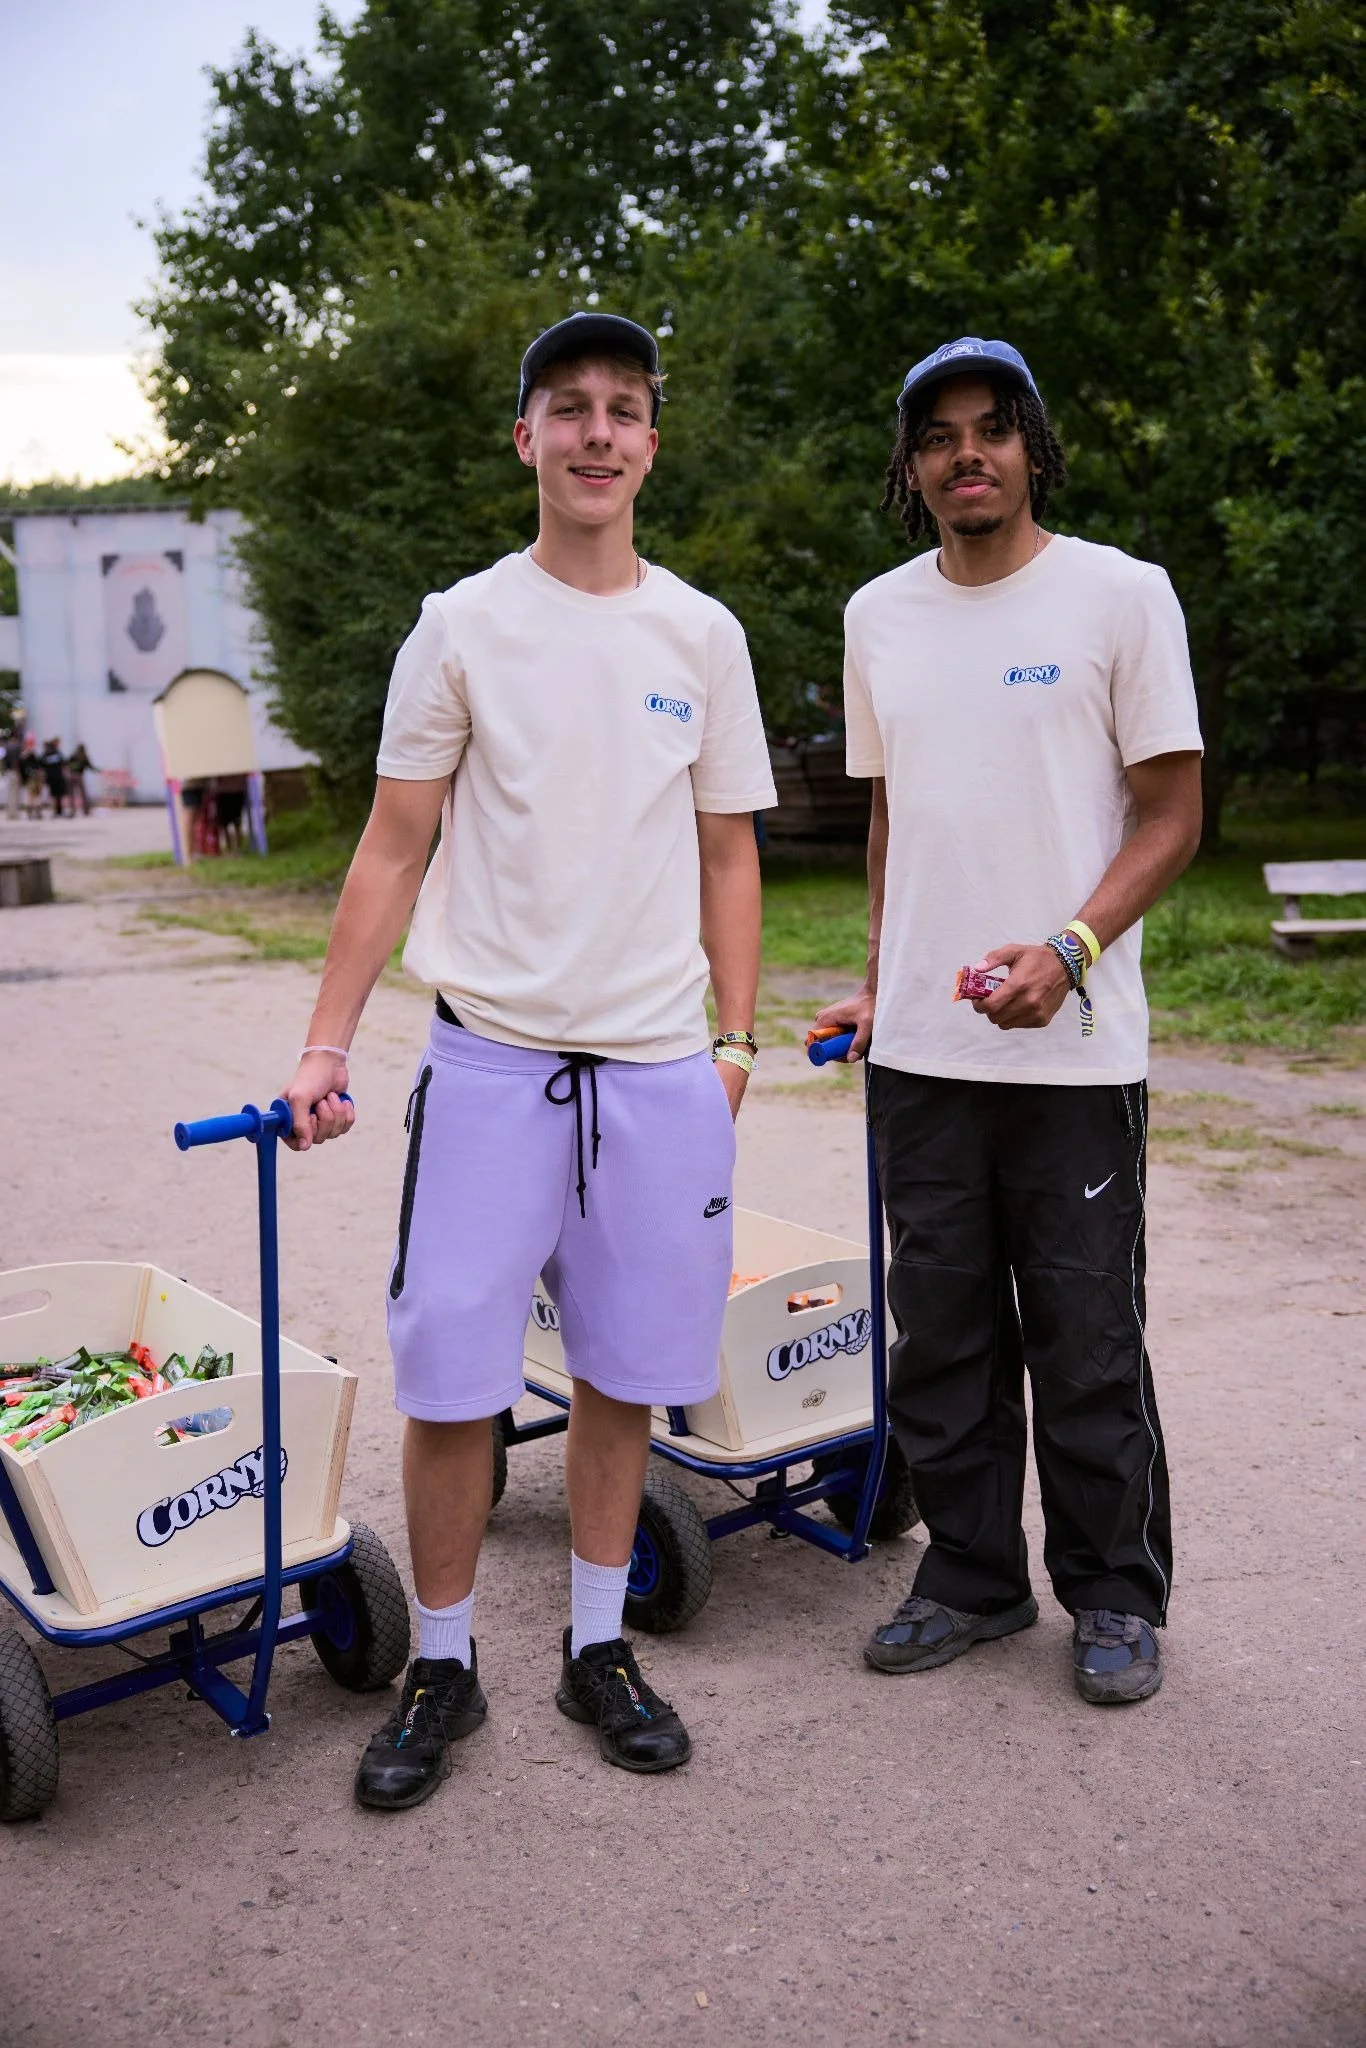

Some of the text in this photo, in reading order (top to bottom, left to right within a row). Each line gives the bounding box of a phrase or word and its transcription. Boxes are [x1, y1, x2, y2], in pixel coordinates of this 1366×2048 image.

[1004, 664, 1060, 685] CORNY
[645, 694, 691, 720] CORNY
[767, 1308, 870, 1381] CORNY
